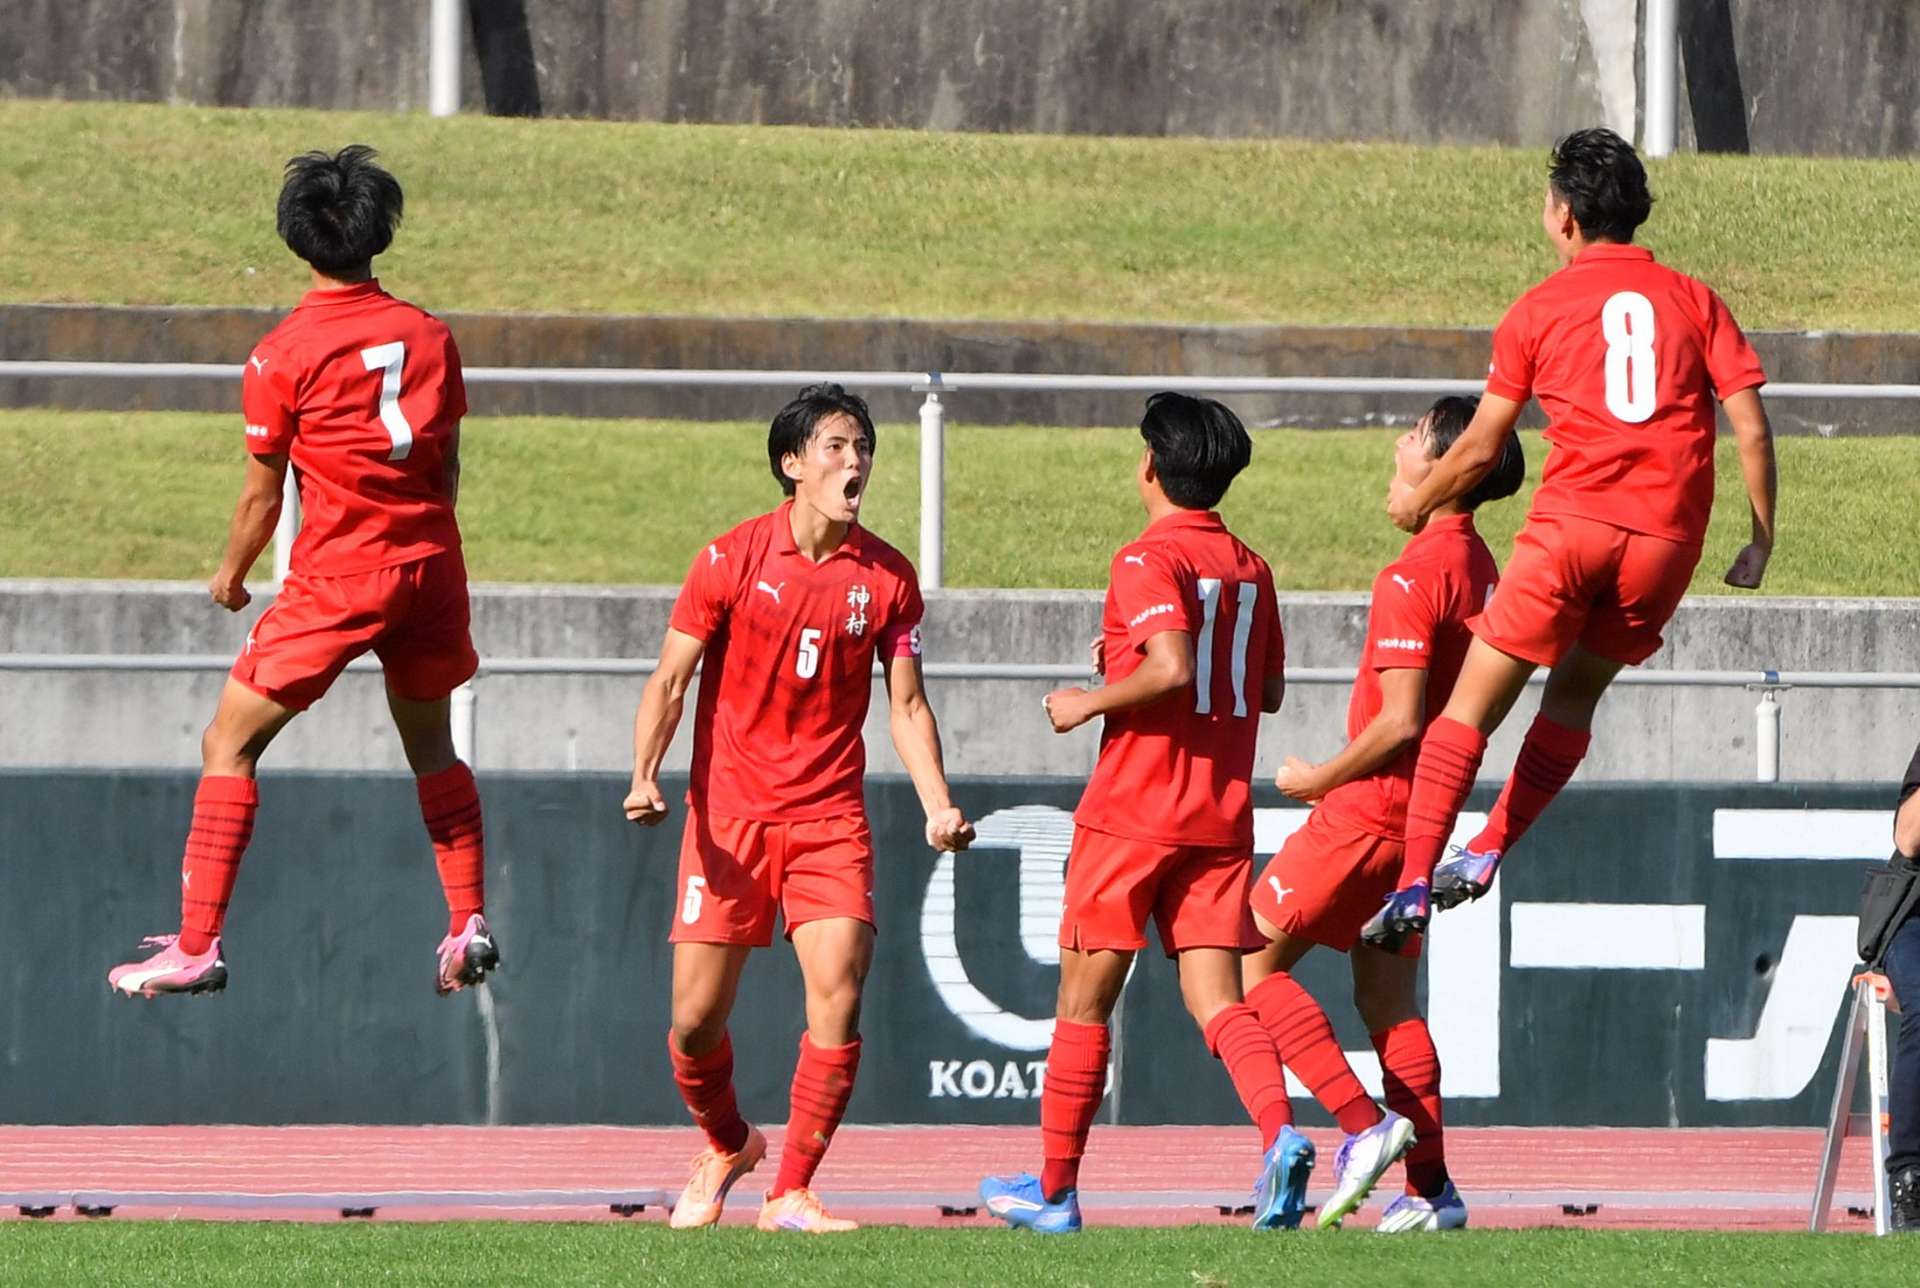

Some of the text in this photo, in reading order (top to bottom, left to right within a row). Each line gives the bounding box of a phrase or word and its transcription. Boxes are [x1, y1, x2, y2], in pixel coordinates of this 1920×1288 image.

[1602, 291, 1656, 423] 8
[361, 341, 413, 460] 7
[796, 628, 822, 679] 5
[845, 585, 870, 637] 神村
[1195, 578, 1257, 718] 11
[681, 875, 705, 925] 5
